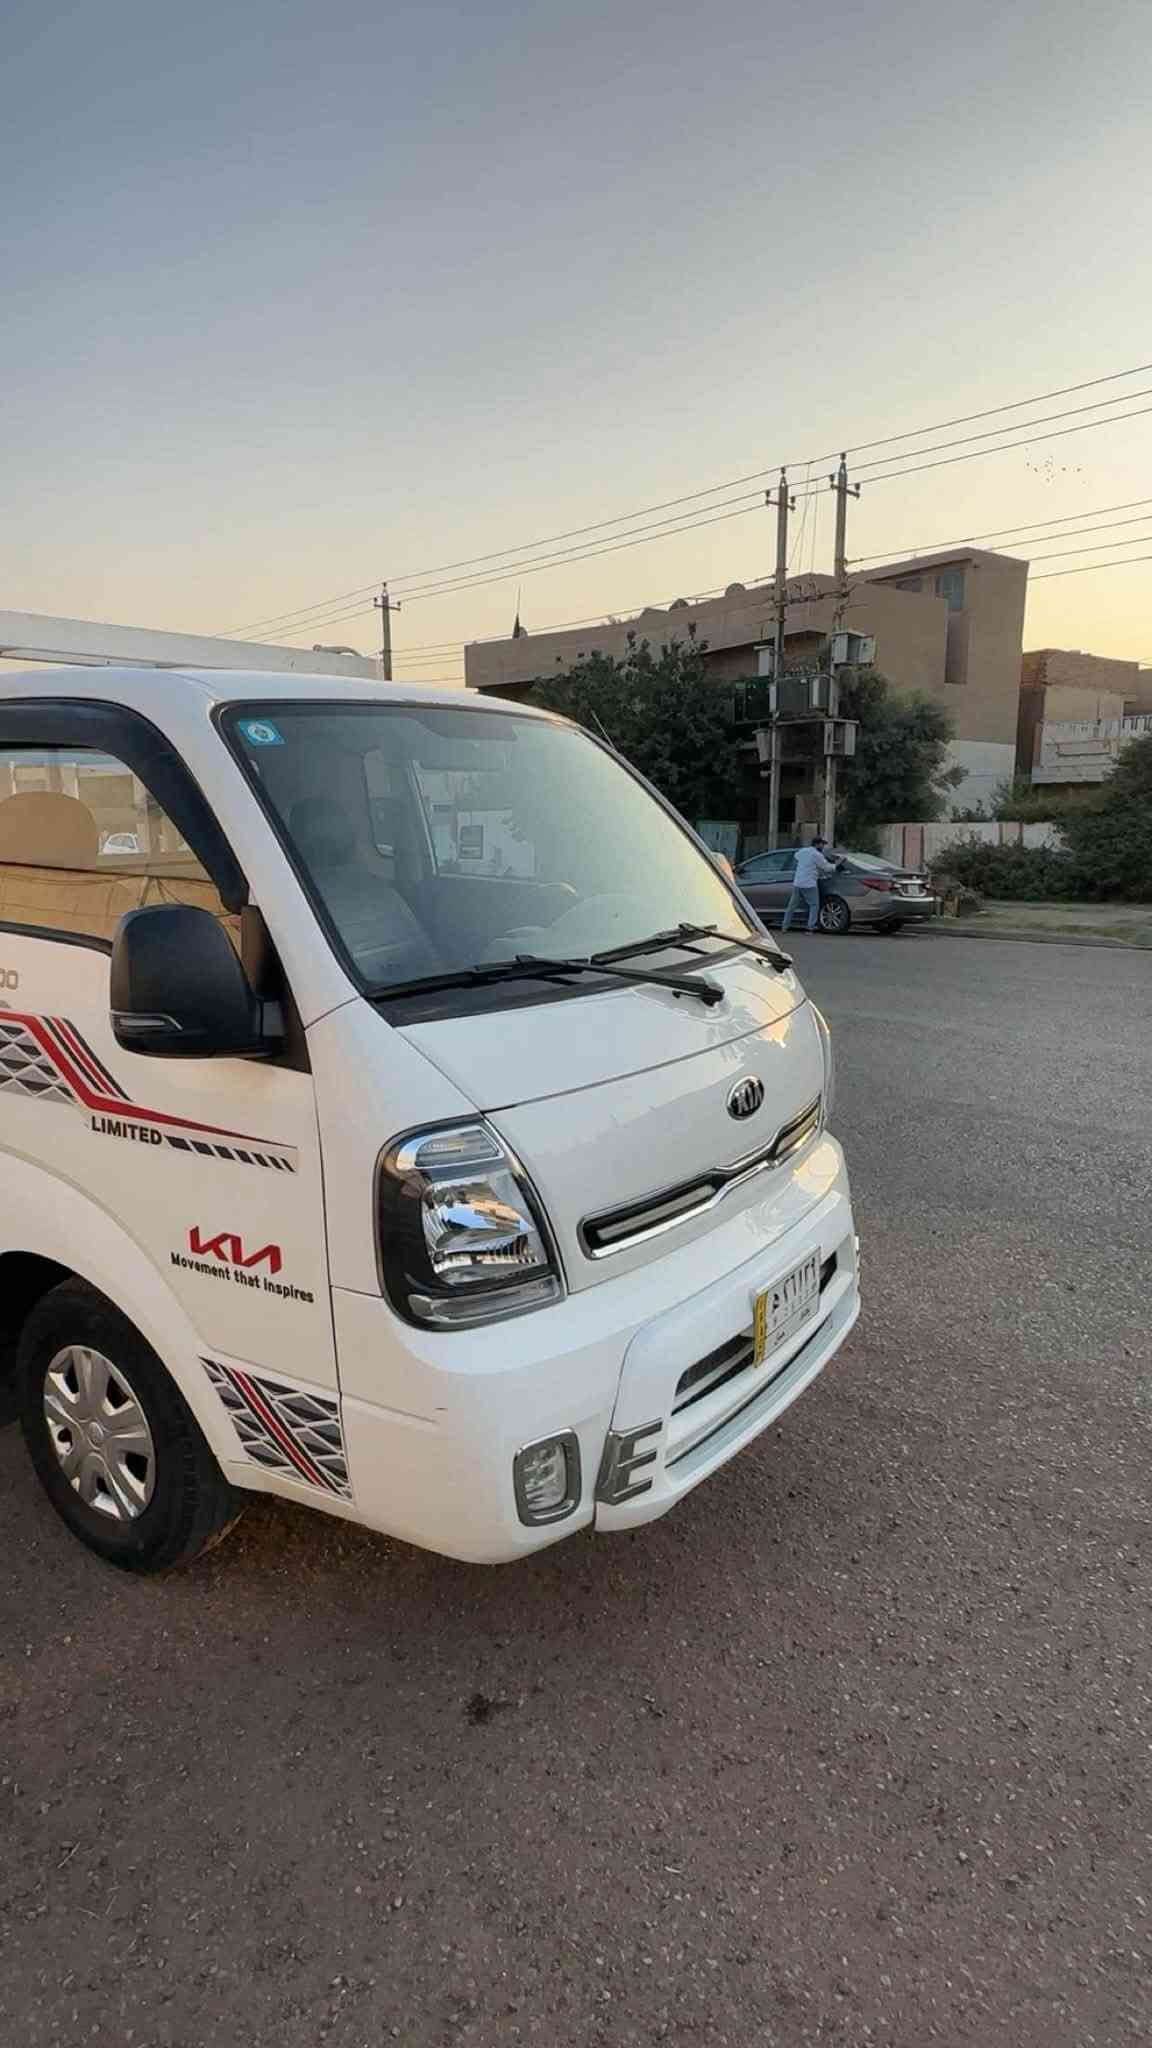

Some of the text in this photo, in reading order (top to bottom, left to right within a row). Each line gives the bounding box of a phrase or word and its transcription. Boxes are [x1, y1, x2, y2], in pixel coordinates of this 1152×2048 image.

[91, 1115, 163, 1146] LIMITED
[189, 1225, 283, 1275] KIA
[170, 1251, 231, 1281] Movement
[233, 1269, 261, 1289] that
